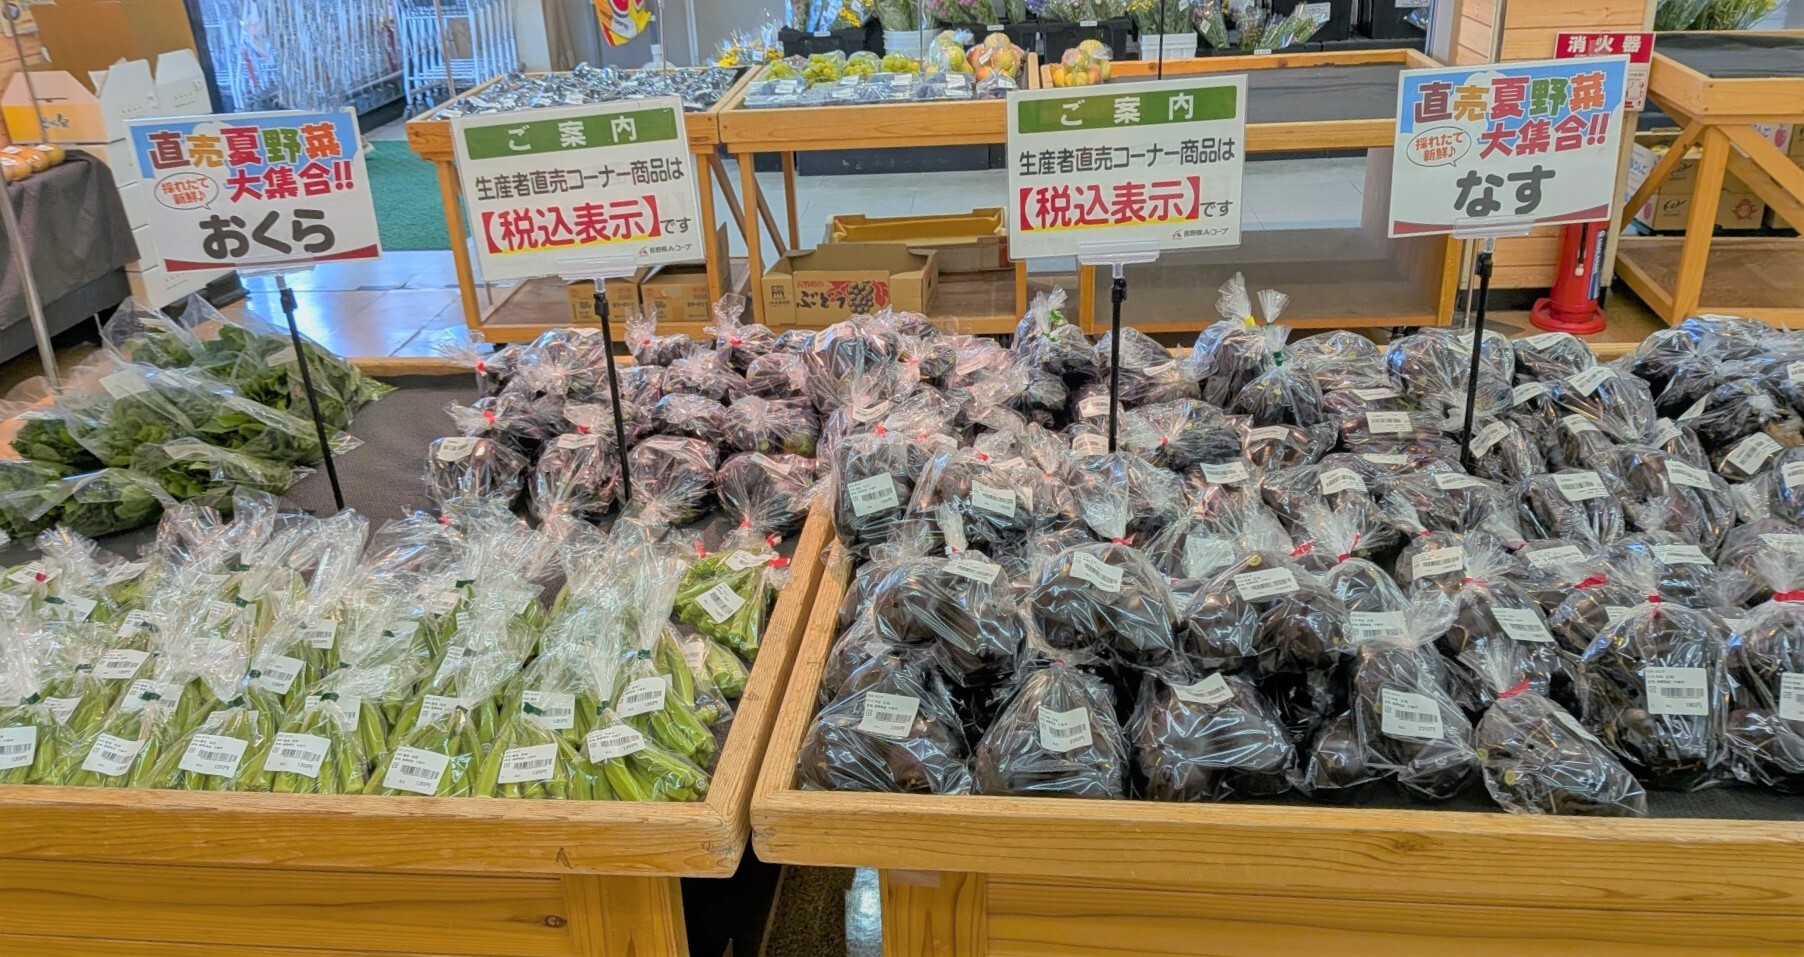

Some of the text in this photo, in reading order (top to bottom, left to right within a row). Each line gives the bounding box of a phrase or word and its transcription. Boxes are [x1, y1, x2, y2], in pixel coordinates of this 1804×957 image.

[1567, 34, 1641, 53] 消火器
[1060, 92, 1194, 126] ご案内
[1414, 70, 1606, 124] 直売夏野菜
[148, 122, 342, 170] 直売夏野菜
[507, 115, 637, 151] ご案内
[1415, 130, 1464, 150] 採れたて
[1019, 137, 1236, 176] 生産者直売コーナー商品は
[161, 177, 210, 195] 採れたて
[475, 157, 685, 201] 生産者直売コーナー商品は
[1453, 164, 1556, 218] なす
[199, 208, 335, 260] おくら
[796, 290, 846, 309] ぶどう
